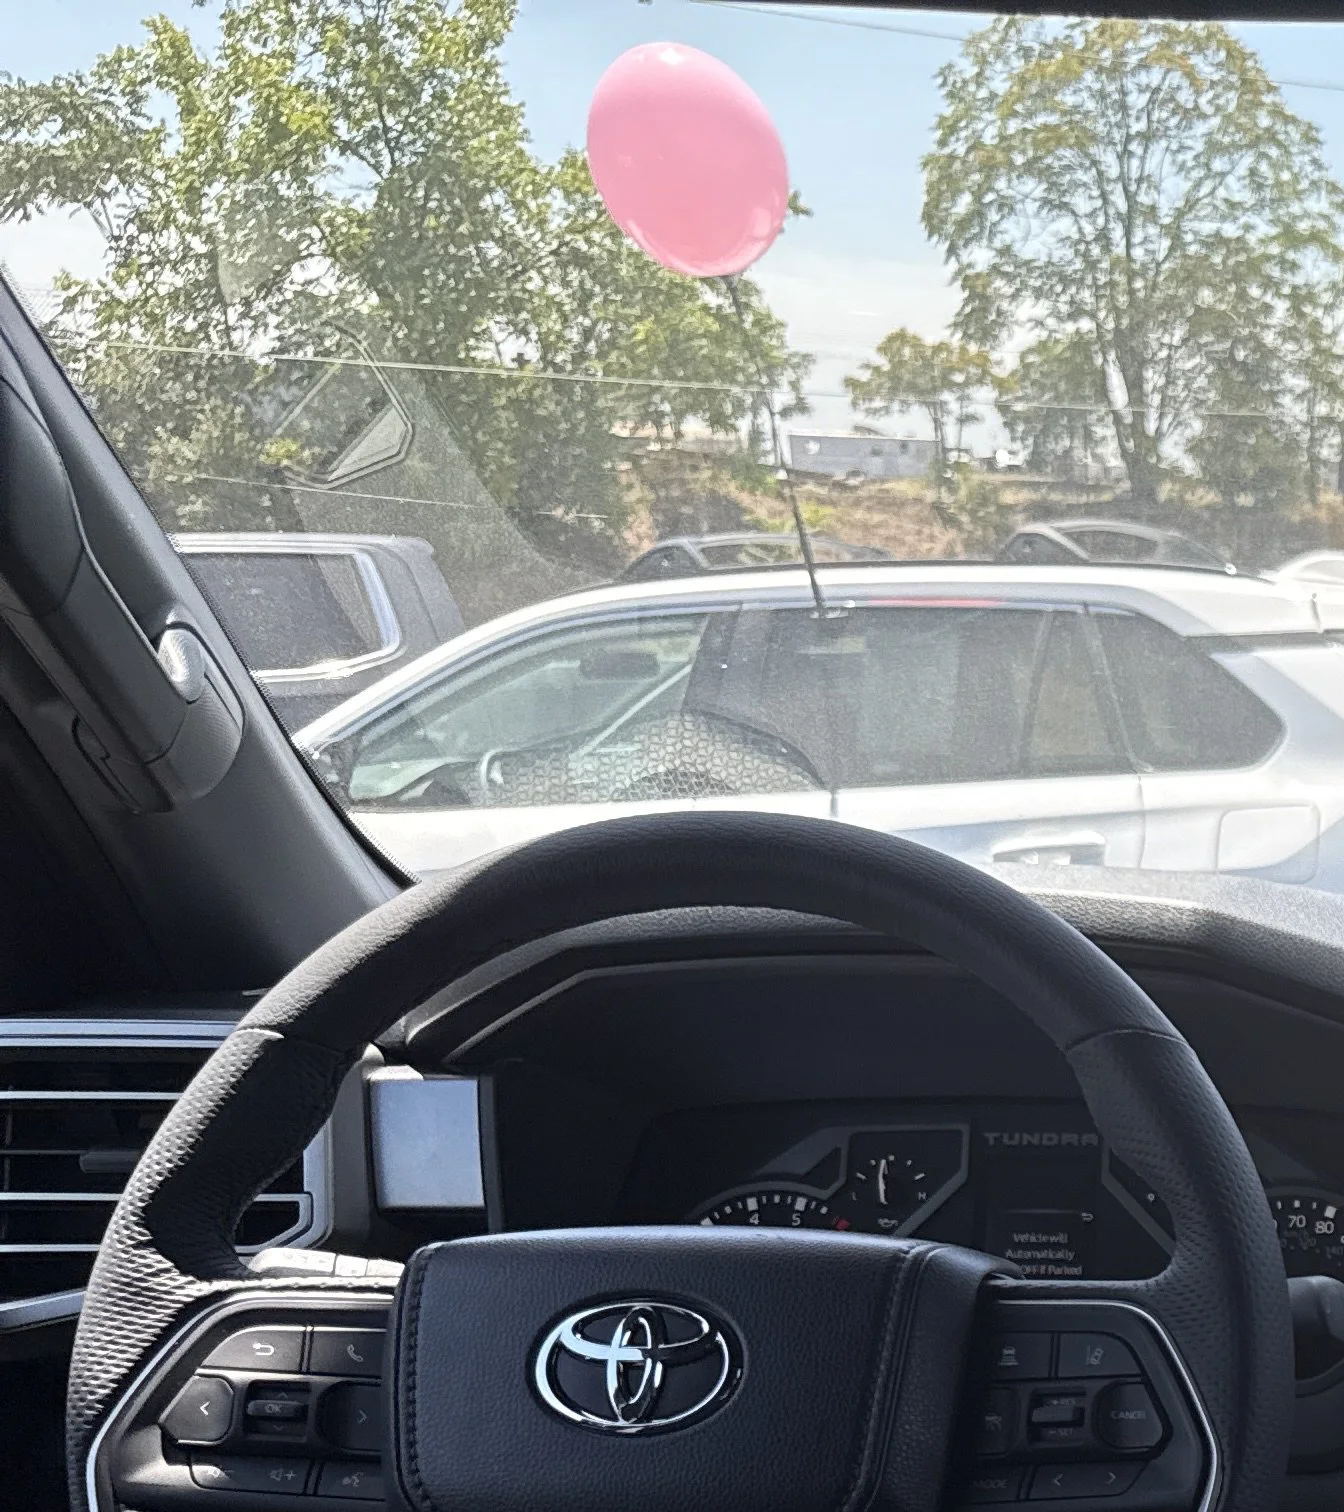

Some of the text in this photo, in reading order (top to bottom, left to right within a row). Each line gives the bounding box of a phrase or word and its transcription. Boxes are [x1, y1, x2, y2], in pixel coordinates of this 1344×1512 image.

[982, 1132, 1099, 1147] TUNDRA
[749, 1213, 760, 1225] 4
[791, 1213, 801, 1226] 5
[1288, 1214, 1307, 1228] 70
[1315, 1220, 1335, 1234] 80
